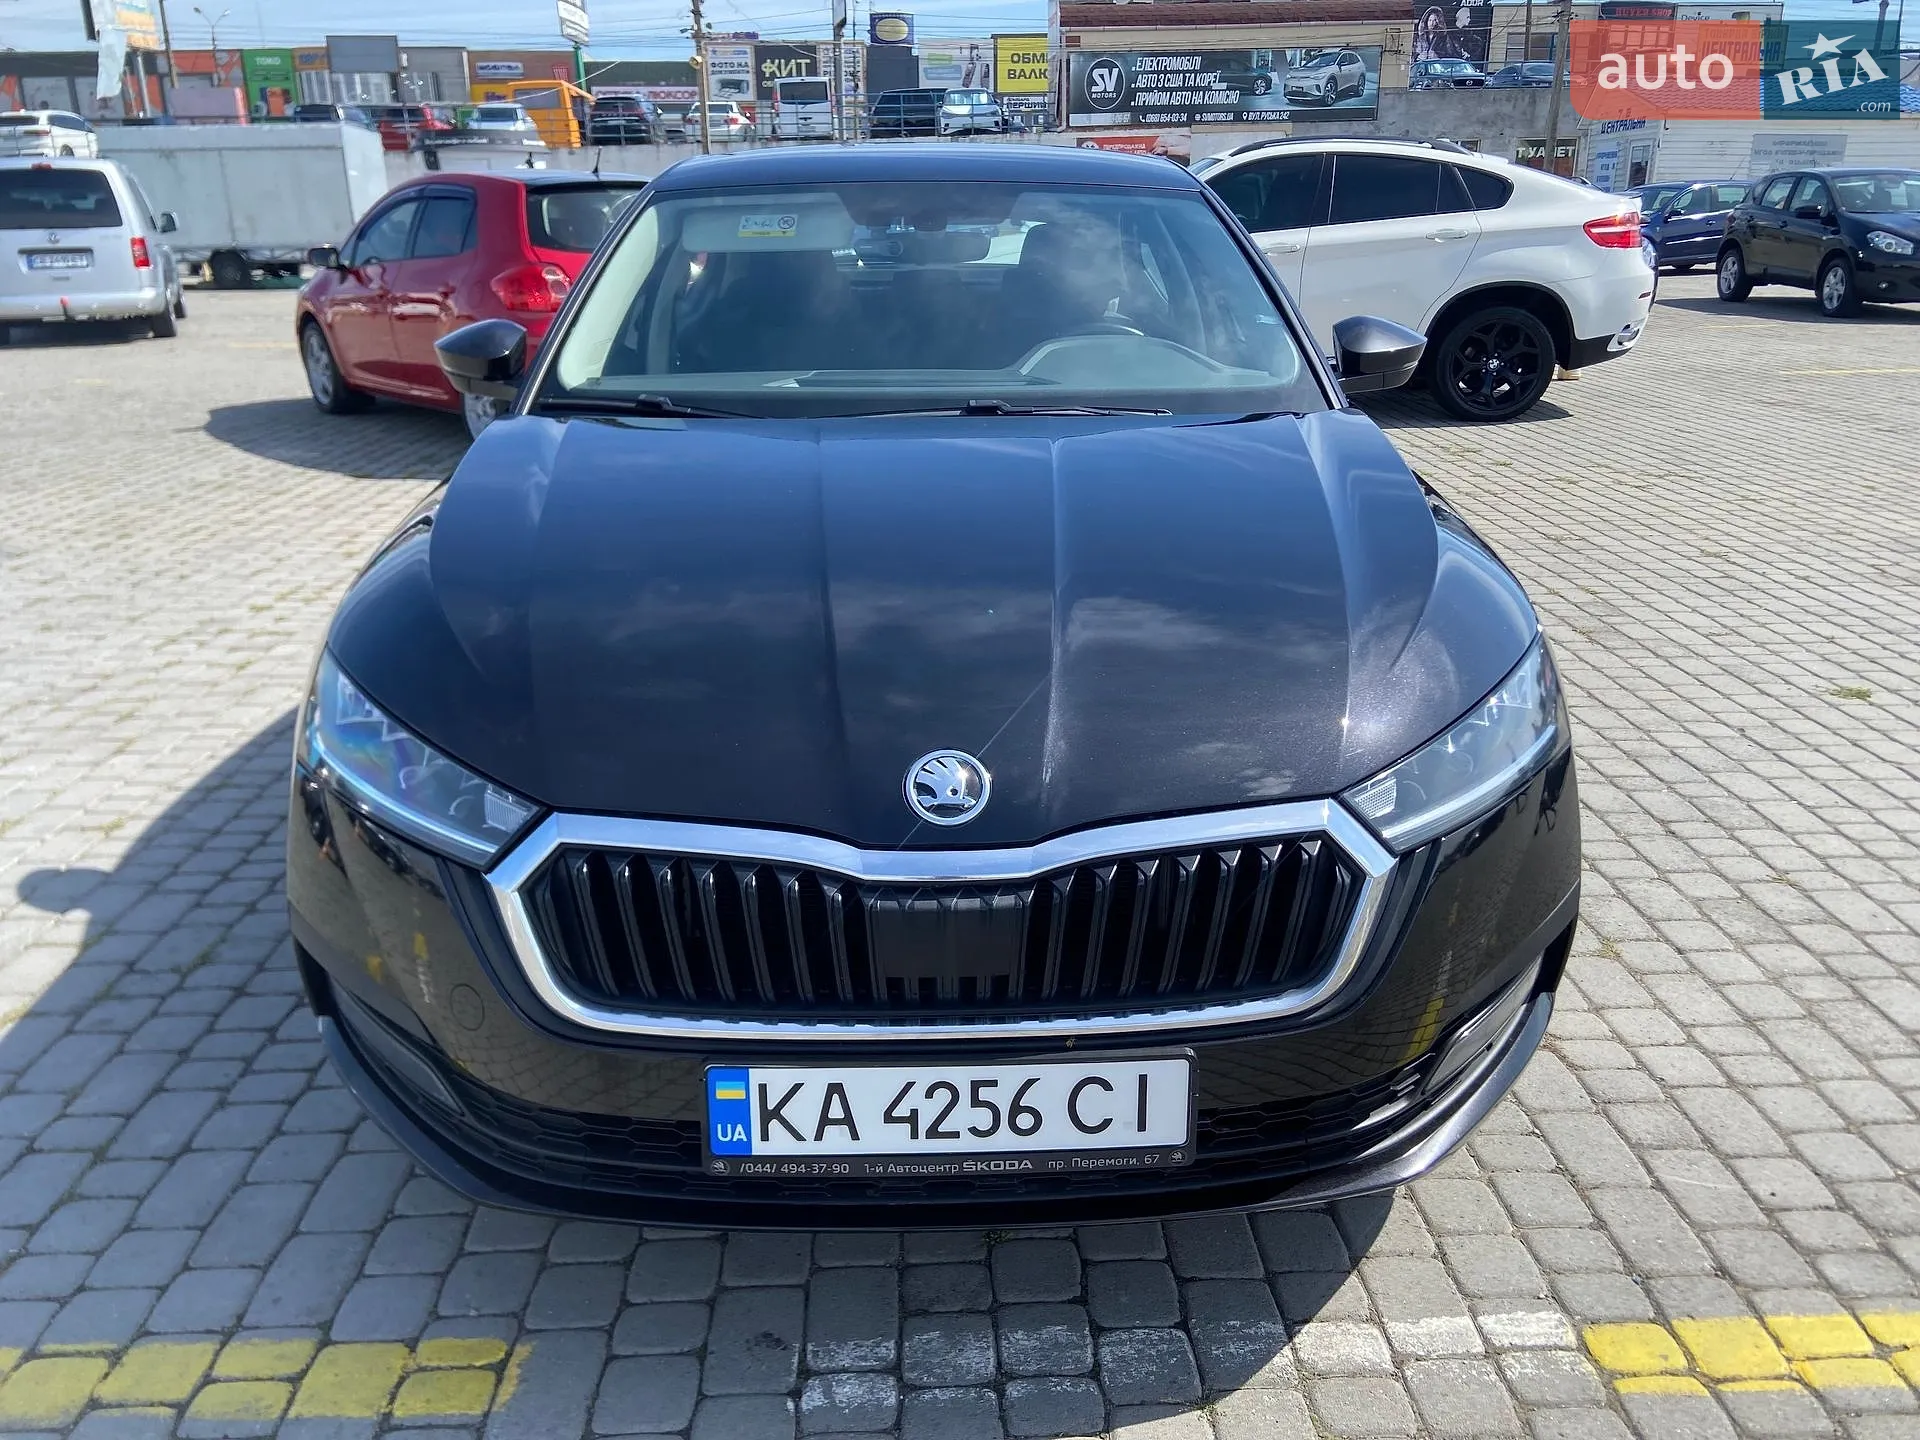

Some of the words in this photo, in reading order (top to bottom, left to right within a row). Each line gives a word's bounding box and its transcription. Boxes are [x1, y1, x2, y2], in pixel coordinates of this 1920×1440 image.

[1136, 56, 1201, 71] ЕЛЕКТРОМОБІЛІ
[1091, 67, 1119, 92] SV
[1136, 74, 1158, 88] АВТО
[1164, 74, 1183, 88] США
[1184, 74, 1196, 87] ТА
[1196, 71, 1221, 87] КОРЕЇ
[1135, 90, 1170, 106] ПРИЙОМ
[1170, 91, 1193, 106] АВТО
[1193, 91, 1202, 105] НА
[1202, 90, 1240, 105] КОМІСІЮ
[1280, 111, 1290, 119] 242
[1517, 146, 1575, 158] ТУАЕТ
[757, 1080, 860, 1142] KA
[883, 1077, 1043, 1140] 4256
[717, 1122, 748, 1142] UA
[781, 1163, 850, 1174] 494-37-90
[864, 1162, 884, 1174] 1-й
[887, 1161, 959, 1174] Автоцентр
[962, 1159, 1033, 1172] ŠKODA
[1048, 1160, 1067, 1170] пр.
[1144, 1154, 1160, 1165] 67
